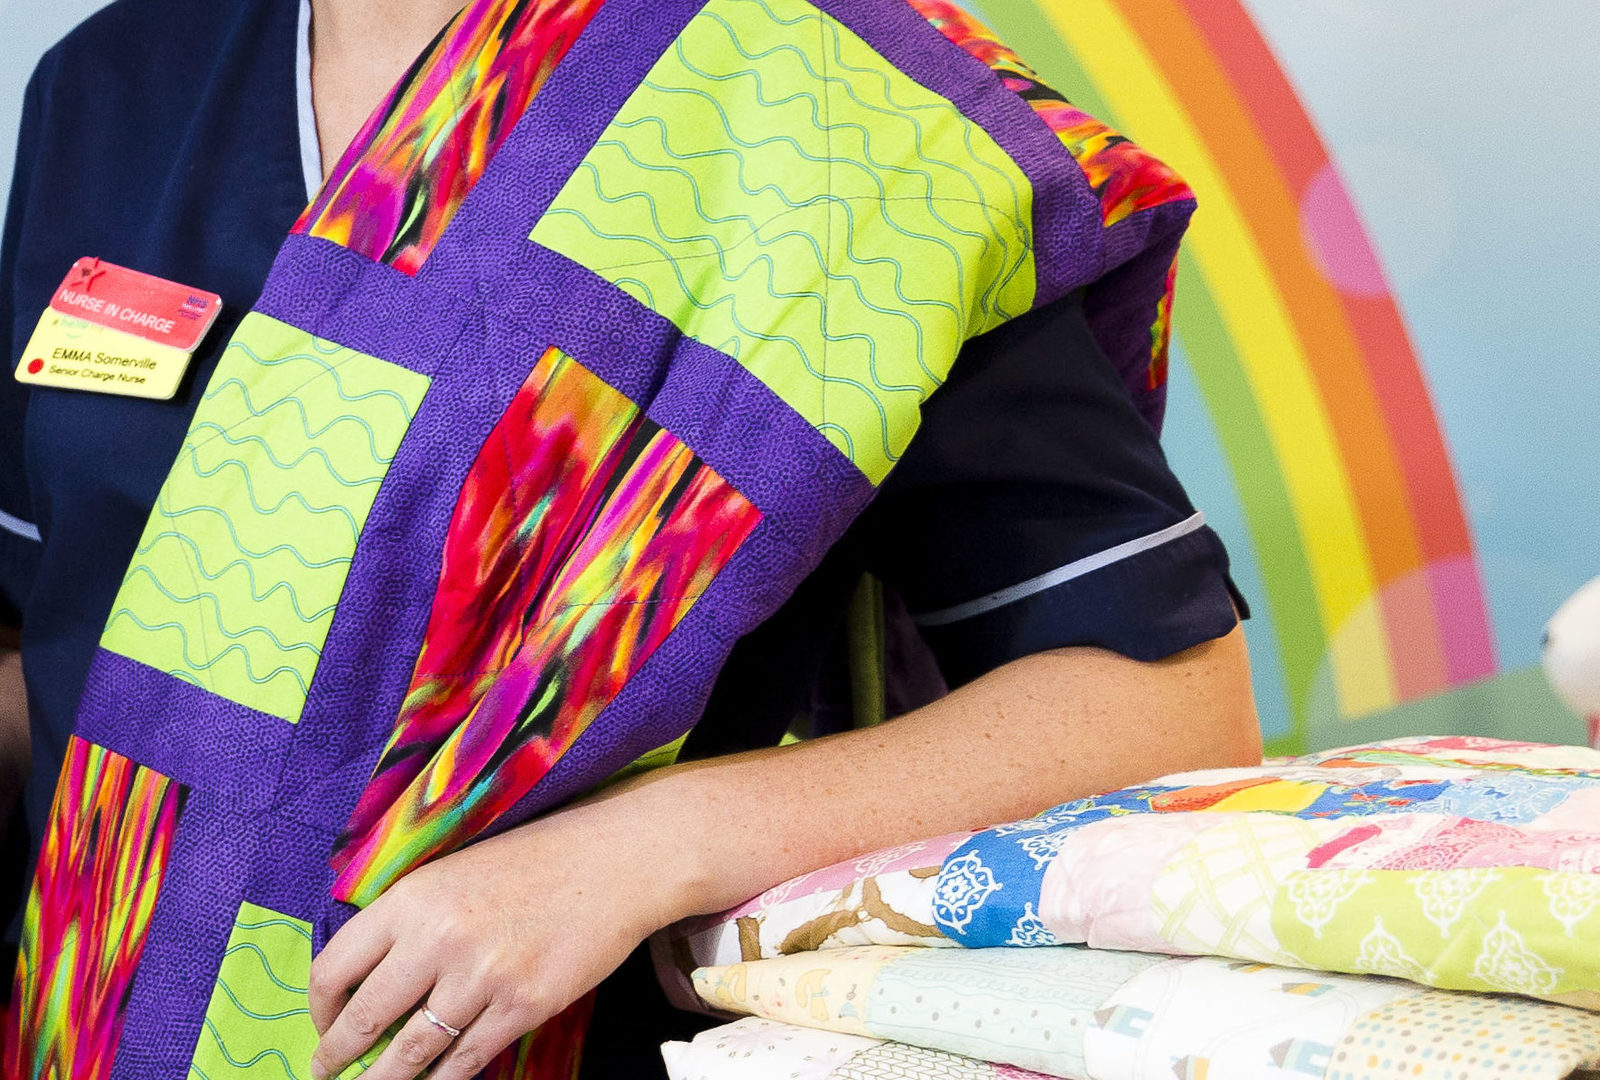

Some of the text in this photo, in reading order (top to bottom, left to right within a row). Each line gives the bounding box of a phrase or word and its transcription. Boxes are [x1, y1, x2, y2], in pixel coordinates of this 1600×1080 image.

[59, 289, 104, 312] NURSE
[104, 303, 120, 317] IN
[119, 308, 175, 333] CHARGE
[53, 348, 157, 370] EMMA Somerville
[49, 365, 146, 384] Senior Charge Nurse
